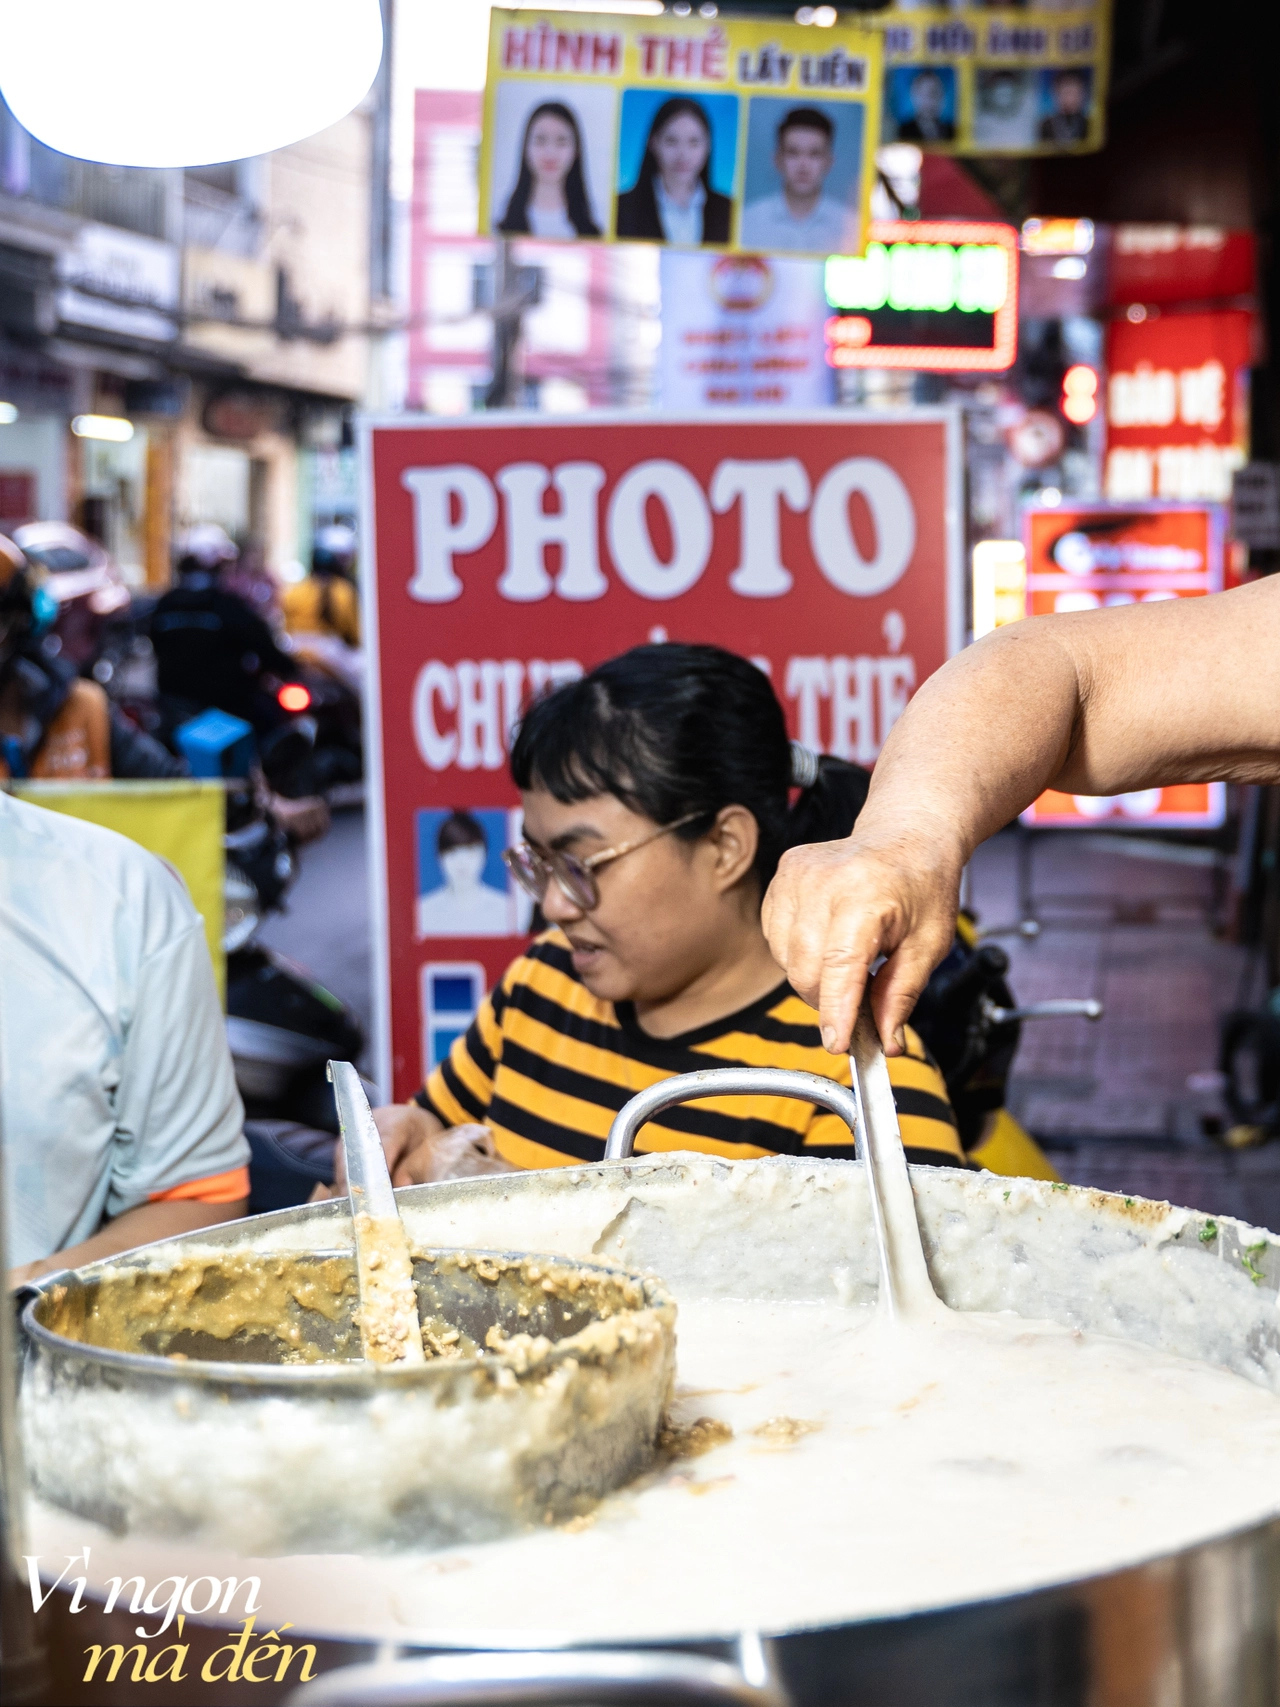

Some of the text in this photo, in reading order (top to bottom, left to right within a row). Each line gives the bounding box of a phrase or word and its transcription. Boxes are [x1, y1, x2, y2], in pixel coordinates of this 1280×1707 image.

[501, 21, 623, 74] HÌNH
[638, 25, 729, 81] THẺ
[401, 456, 916, 602] PHOTO
